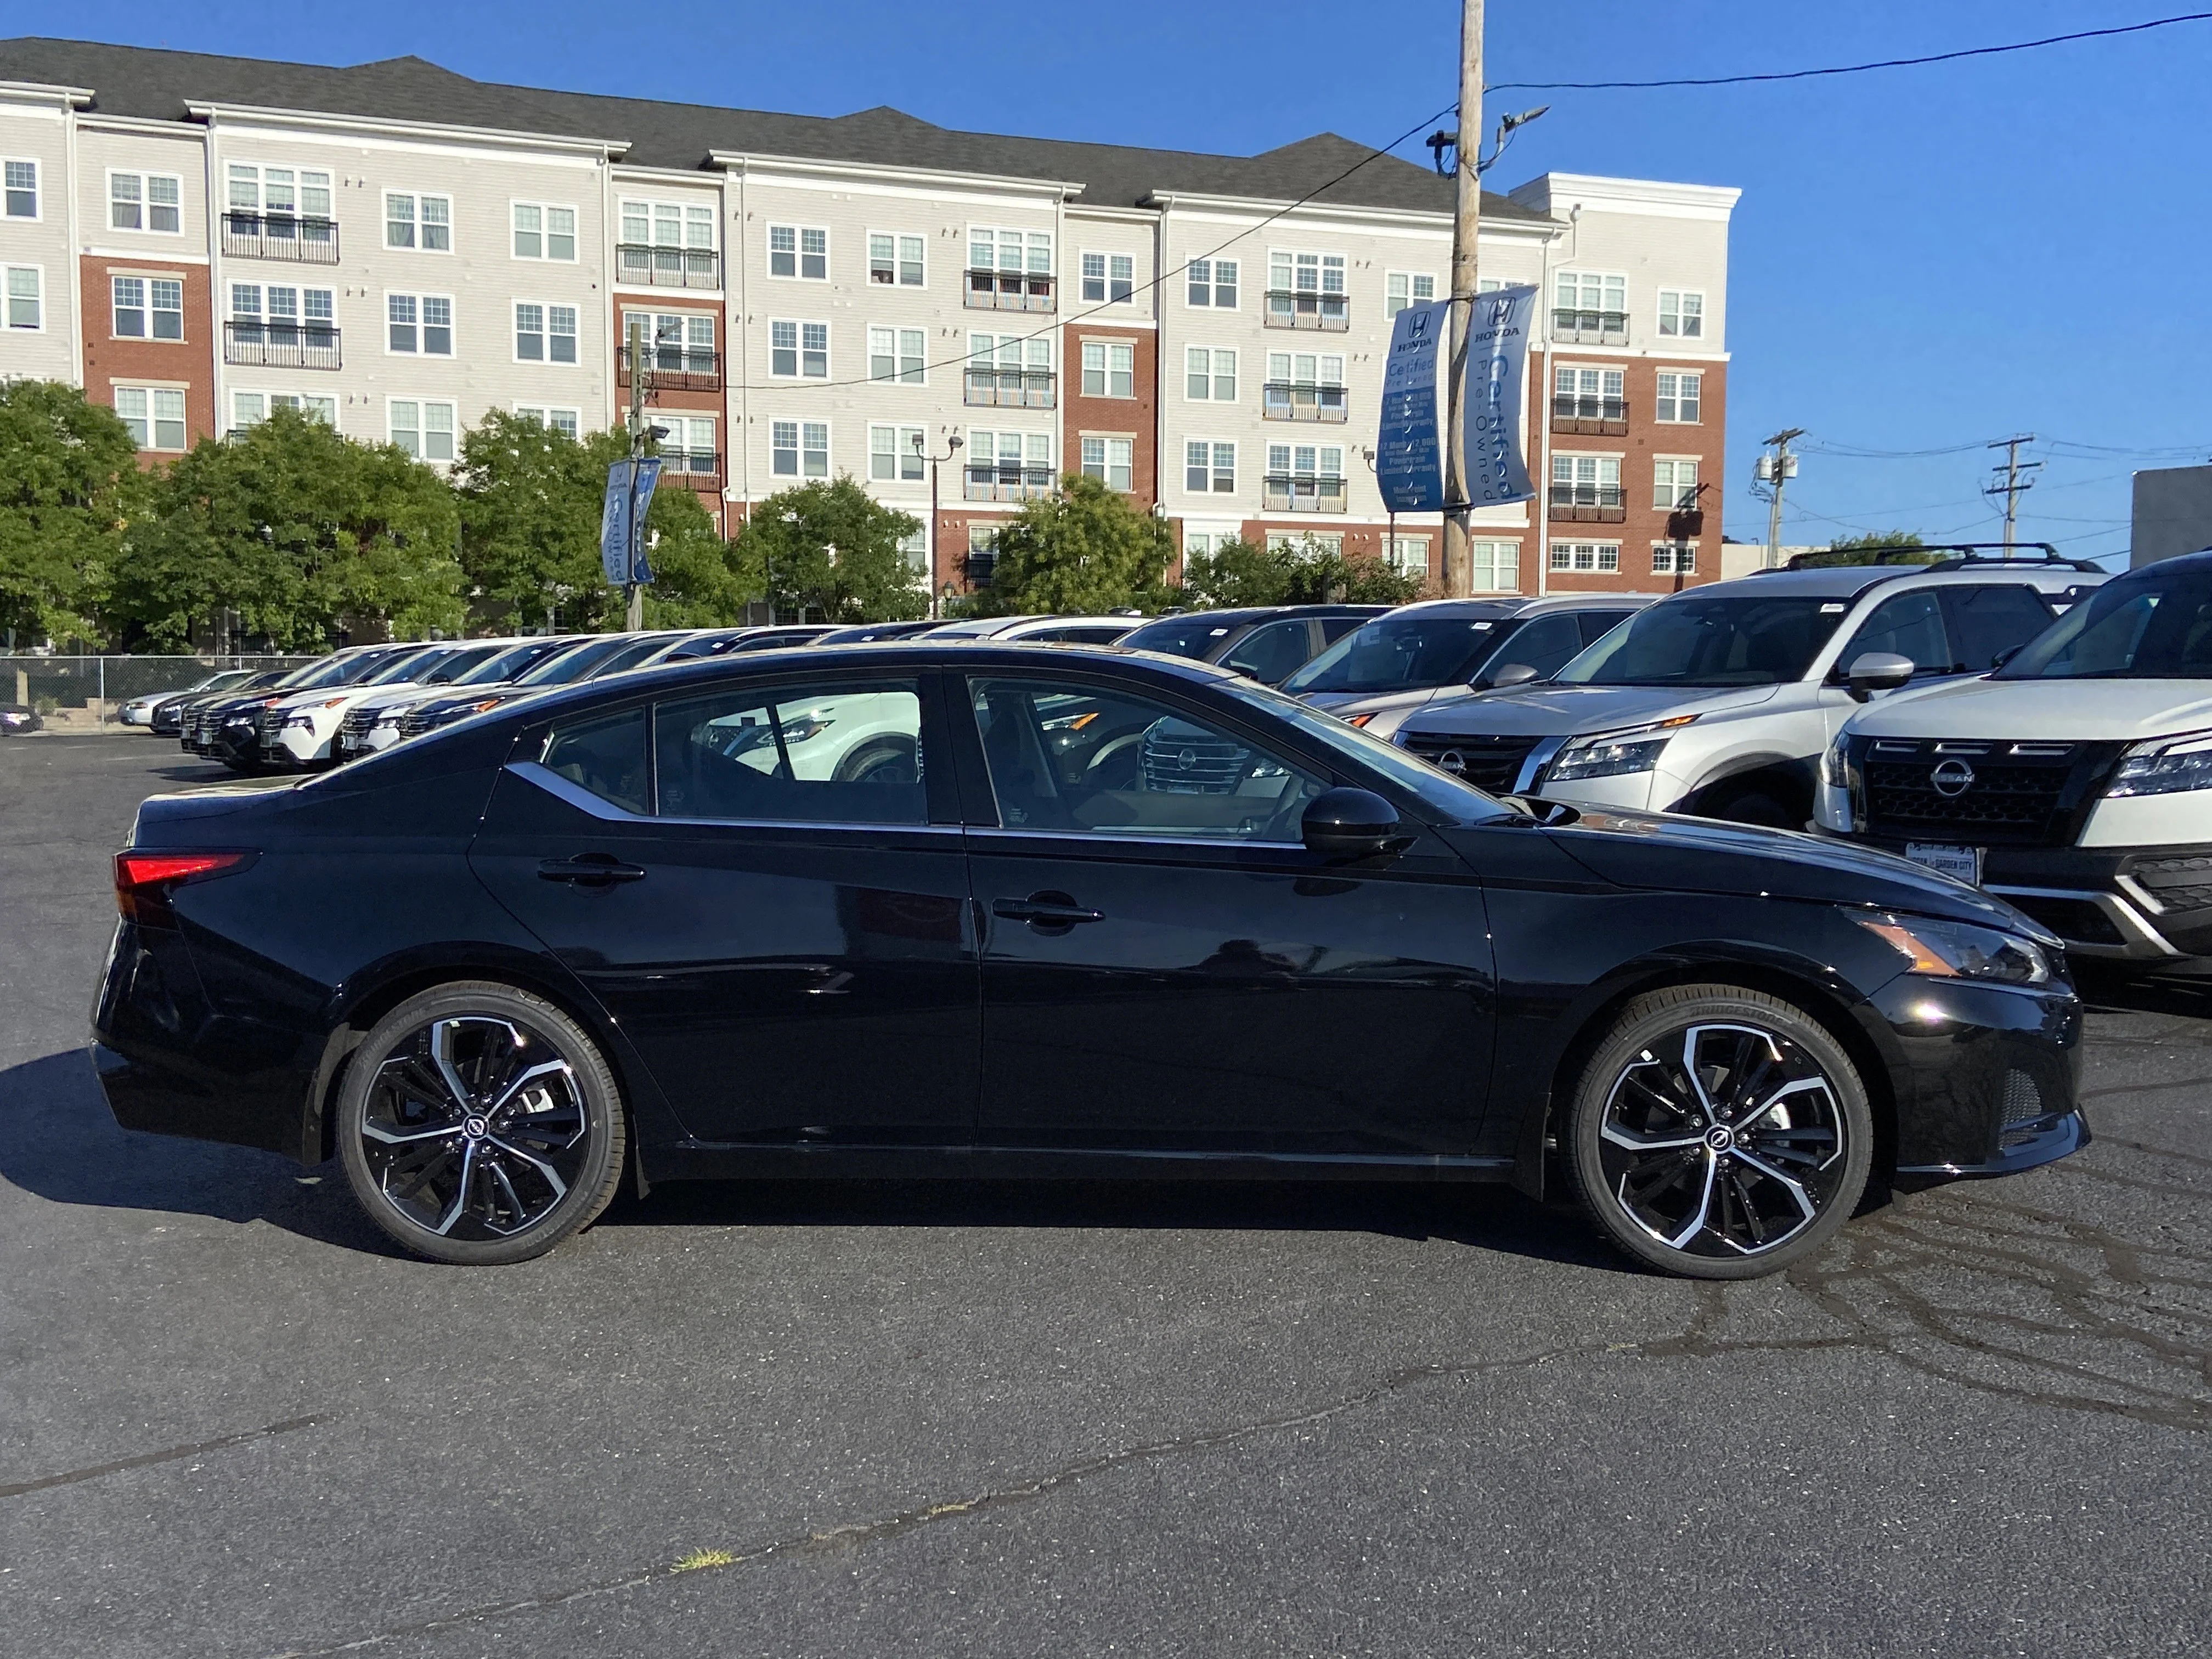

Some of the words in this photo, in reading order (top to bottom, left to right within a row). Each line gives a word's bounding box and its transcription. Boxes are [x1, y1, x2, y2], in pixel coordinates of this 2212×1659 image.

[1475, 328, 1520, 343] HONDA
[1397, 338, 1432, 352] HONDA
[1389, 354, 1434, 376] Cetified
[1475, 359, 1497, 500] Pre-Owned
[1488, 355, 1521, 499] Certified
[1404, 464, 1436, 473] Wrranty
[1959, 861, 1972, 870] CITY
